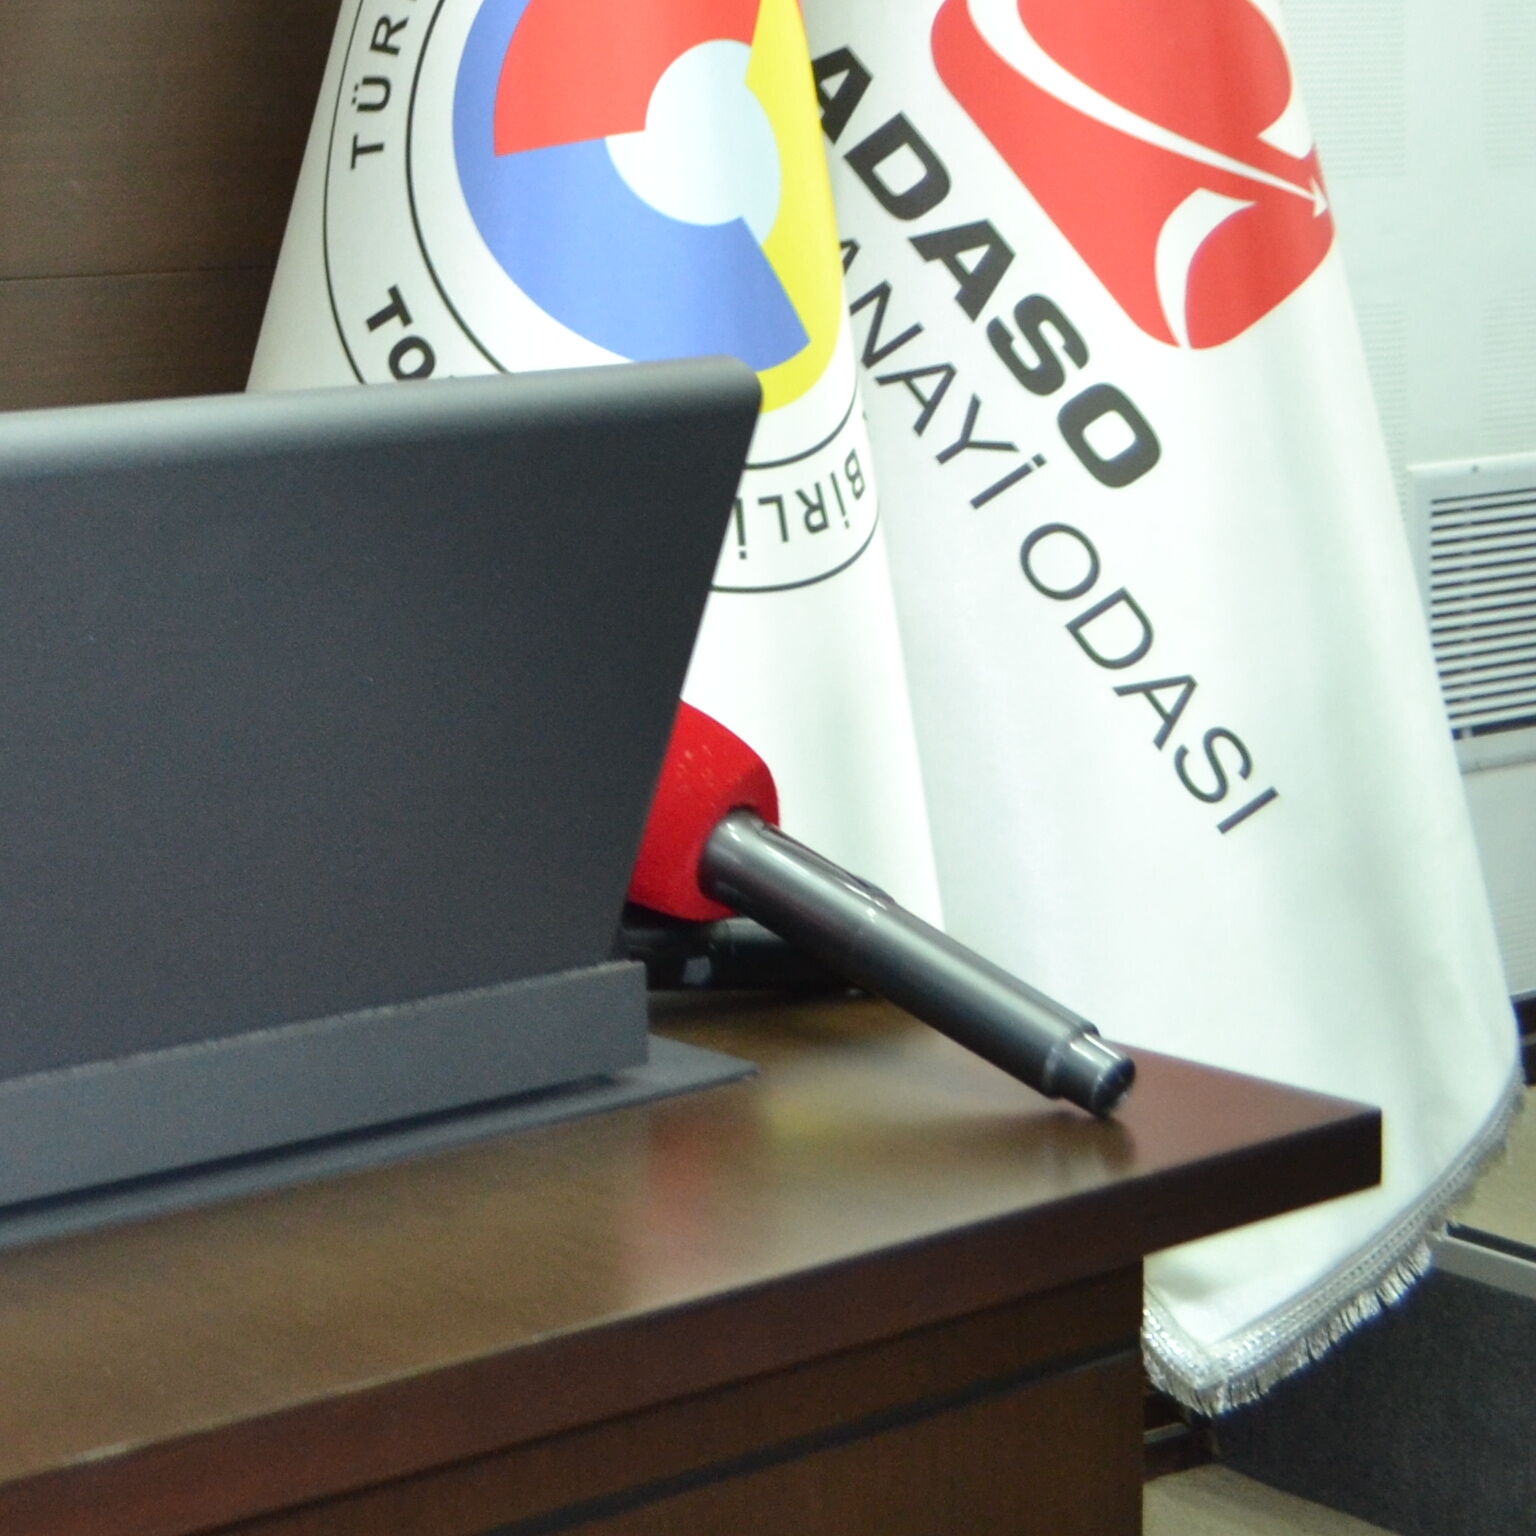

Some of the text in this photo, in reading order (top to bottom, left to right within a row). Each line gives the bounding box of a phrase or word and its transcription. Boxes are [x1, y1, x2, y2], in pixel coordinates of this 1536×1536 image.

[366, 284, 436, 382] TO
[812, 46, 1162, 489] ADASO
[734, 447, 866, 560] BİRLİ
[1020, 521, 1280, 835] ODASI
